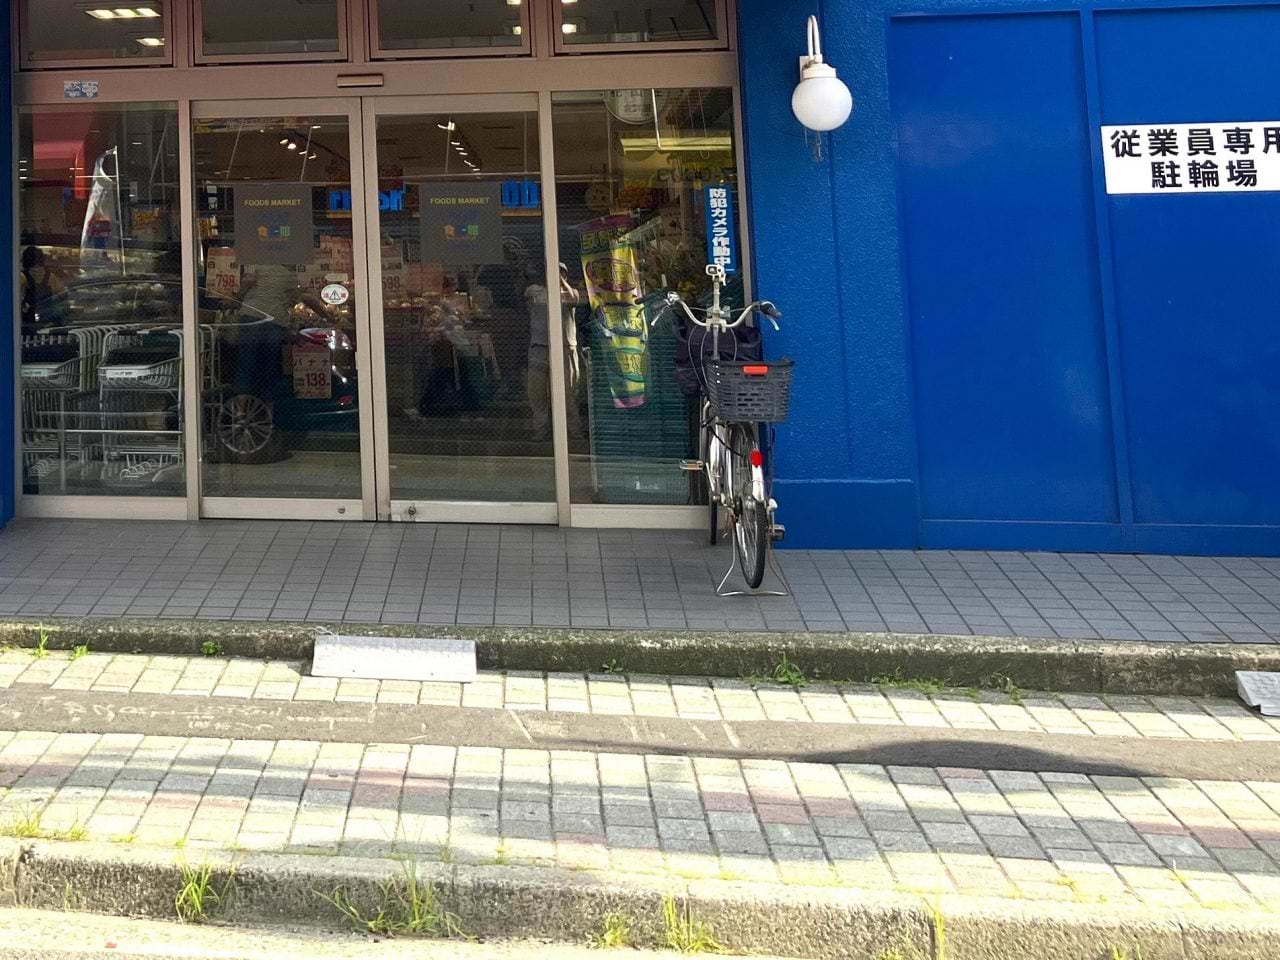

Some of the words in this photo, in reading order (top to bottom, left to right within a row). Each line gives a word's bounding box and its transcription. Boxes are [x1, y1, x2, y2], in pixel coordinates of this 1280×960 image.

[1110, 126, 1280, 158] 従業員専用
[1150, 159, 1258, 189] 駐輪場
[270, 198, 301, 206] MARKET
[709, 188, 731, 267] 防犯カメラ作動中
[216, 274, 235, 288] 798
[305, 372, 326, 387] 138
